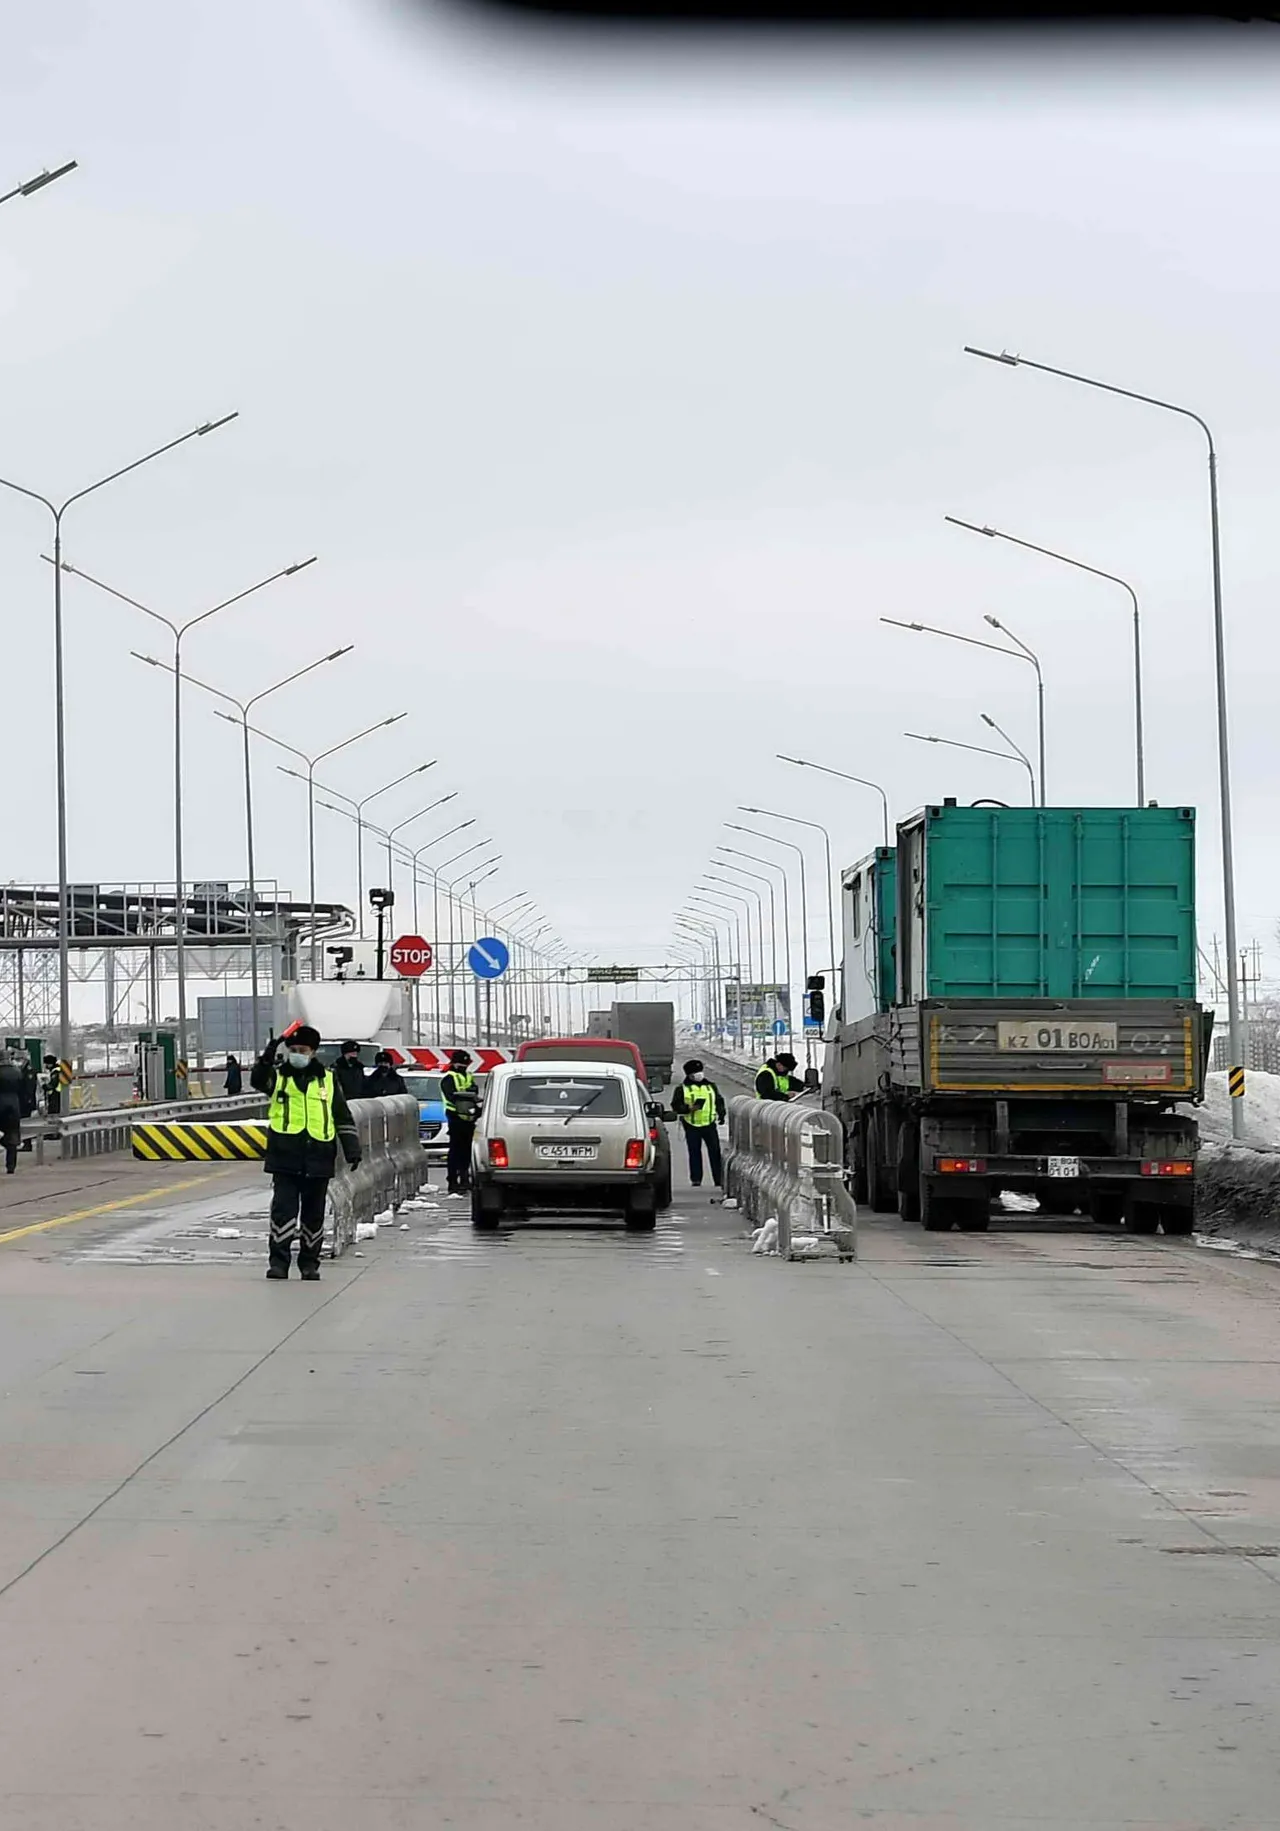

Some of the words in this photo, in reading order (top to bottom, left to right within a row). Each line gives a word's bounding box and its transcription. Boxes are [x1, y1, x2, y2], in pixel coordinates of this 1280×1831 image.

[392, 949, 431, 964] STOP
[1008, 1036, 1029, 1048] KZ
[1037, 1028, 1063, 1049] 01
[540, 1147, 549, 1156] C
[551, 1146, 569, 1156] 451
[571, 1146, 593, 1156] WFM
